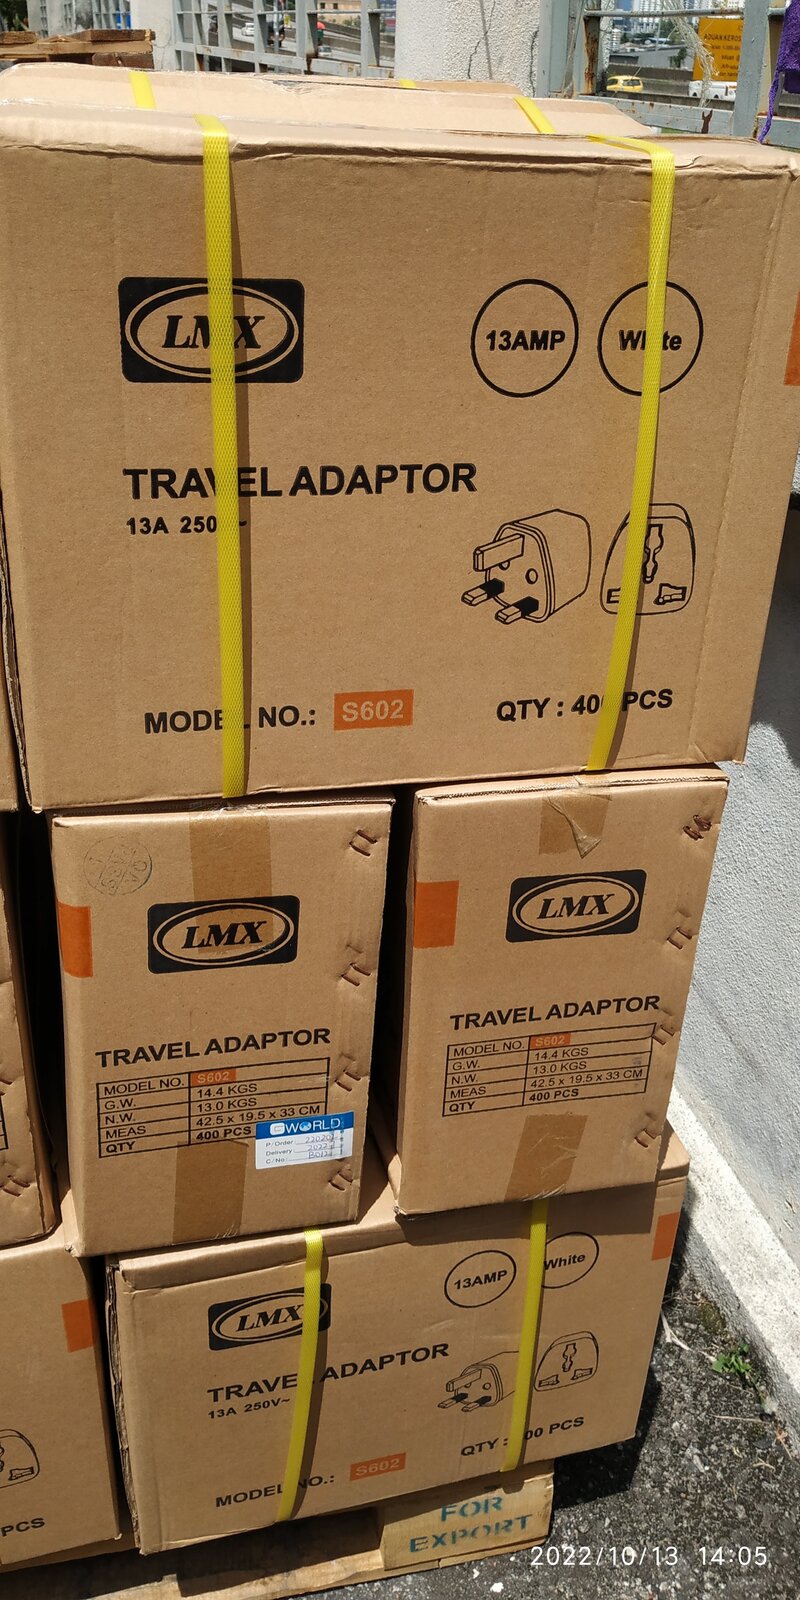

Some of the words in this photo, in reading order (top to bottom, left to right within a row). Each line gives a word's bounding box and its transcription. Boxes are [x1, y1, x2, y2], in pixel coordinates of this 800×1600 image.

[486, 329, 565, 351] 13AMP
[288, 463, 477, 495] ADAPTOR
[126, 517, 169, 535] 13A
[180, 515, 248, 534] 250~
[258, 705, 316, 728] NO.:
[341, 699, 404, 722] S602
[496, 697, 550, 722] QTY
[571, 693, 605, 716] 40
[621, 688, 673, 712] PCS
[537, 893, 615, 919] LMX
[181, 920, 267, 949] LMX
[450, 1006, 541, 1030] TRAVEL
[546, 995, 660, 1020] ADAPTOR
[95, 1040, 200, 1068] TRAVEL
[204, 1028, 331, 1056] ADAPTOR
[452, 1059, 481, 1072] G.W.
[534, 1050, 558, 1061] 14.4
[562, 1046, 589, 1058] KGS
[453, 1042, 499, 1058] MODEL
[502, 1039, 525, 1052] NO.
[535, 1035, 566, 1047] S602
[104, 1080, 156, 1096] MODEL
[159, 1077, 185, 1090] NO.
[197, 1070, 230, 1084] S602
[450, 1085, 487, 1100] MEAS
[530, 1076, 555, 1089] 42.5
[558, 1077, 565, 1085] x
[570, 1072, 593, 1084] 19.5
[595, 1074, 603, 1082] x
[605, 1070, 621, 1080] 33
[623, 1068, 643, 1079] CM
[451, 1072, 478, 1086] N.W.
[533, 1063, 557, 1075] 13.0
[560, 1060, 587, 1072] KGS
[104, 1097, 137, 1111] G.W.
[197, 1087, 223, 1099] 14.4
[228, 1083, 257, 1096] KGS
[105, 1112, 136, 1125] N.W.
[197, 1101, 224, 1113] 13.0
[228, 1097, 257, 1110] KGS
[449, 1100, 476, 1114] QTY
[529, 1091, 550, 1103] 400
[554, 1087, 579, 1100] PCS
[105, 1125, 147, 1141] MEAS
[196, 1114, 223, 1127] 42.5
[227, 1116, 235, 1125] x
[240, 1110, 266, 1123] 19.5
[269, 1111, 276, 1119] x
[279, 1107, 296, 1117] 33
[299, 1104, 320, 1116] CM
[106, 1140, 135, 1154] QTY
[196, 1130, 220, 1142] 400
[225, 1126, 252, 1139] PCS
[543, 1253, 586, 1271] White
[454, 1269, 508, 1291] 13AMP
[235, 1303, 305, 1332] LMX
[207, 1372, 314, 1403] TRAVE
[319, 1342, 449, 1383] ADAPTOR
[208, 1406, 238, 1419] 13A
[461, 1438, 499, 1456] QTY
[549, 1416, 584, 1434] PCS
[355, 1457, 400, 1478] S602
[441, 1496, 503, 1522] FOR
[1, 1517, 46, 1537] PCS
[409, 1513, 533, 1553] EXPORT
